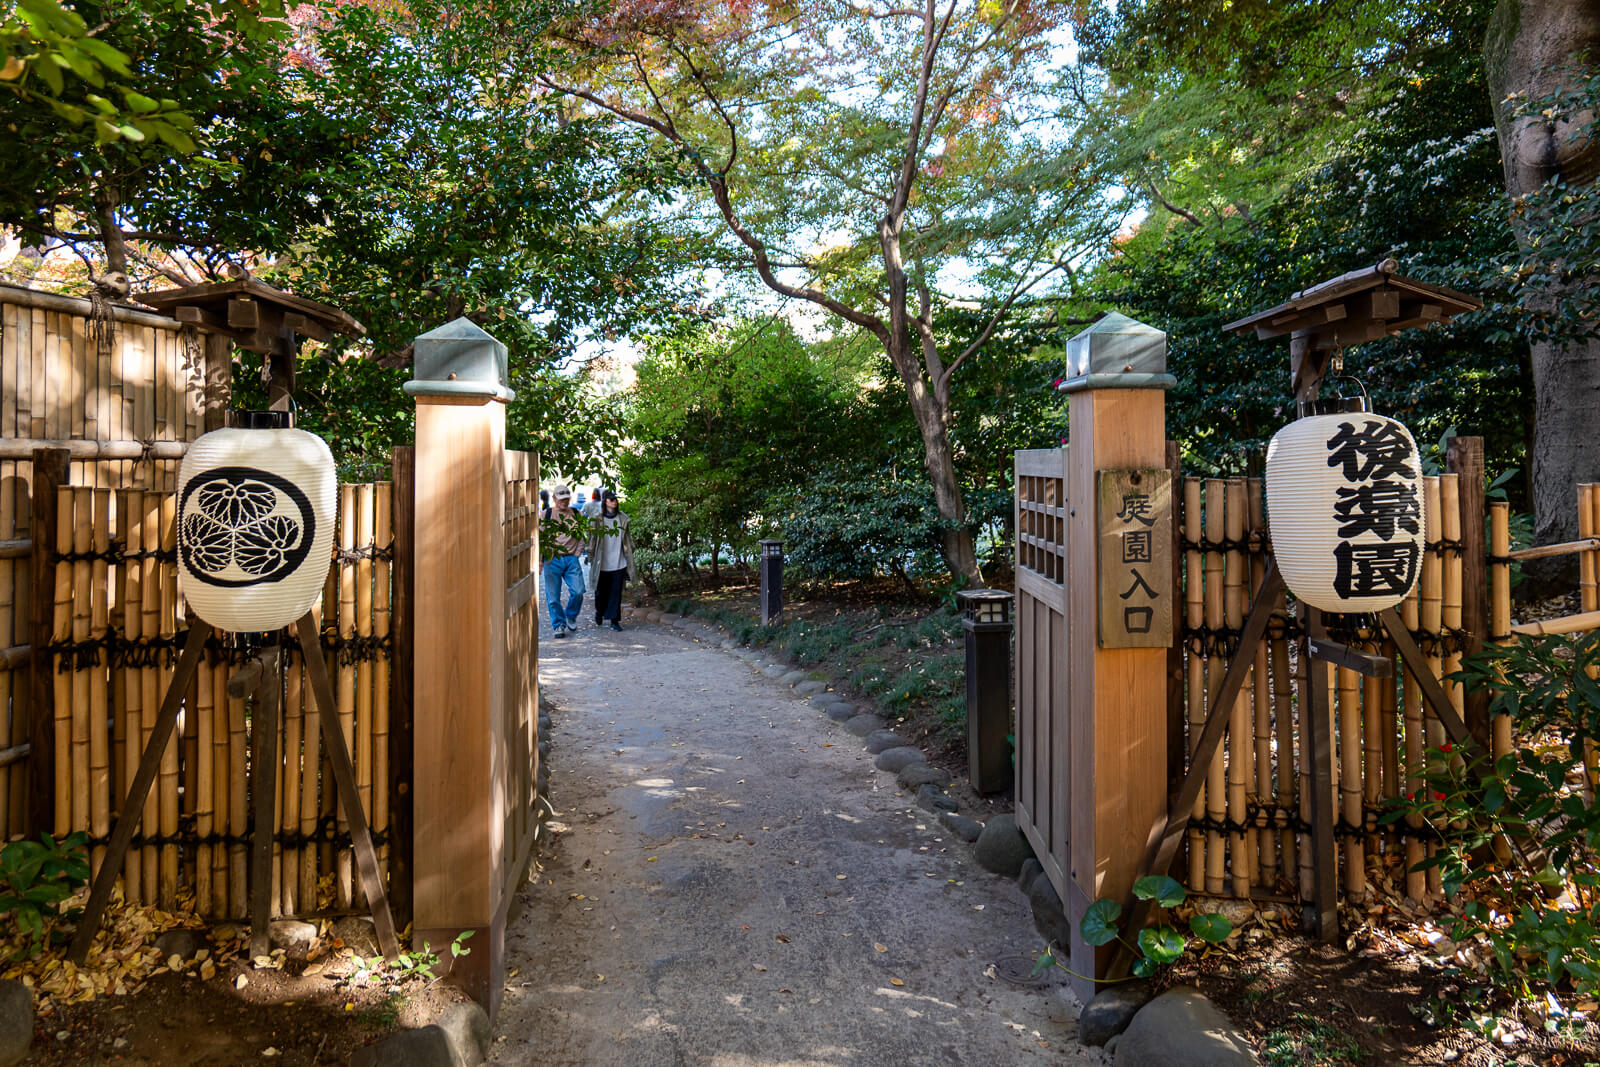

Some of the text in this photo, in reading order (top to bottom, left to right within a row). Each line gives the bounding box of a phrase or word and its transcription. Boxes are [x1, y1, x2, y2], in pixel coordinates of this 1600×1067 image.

[1116, 495, 1159, 633] 庭園入口
[1327, 421, 1420, 599] 後楽園
